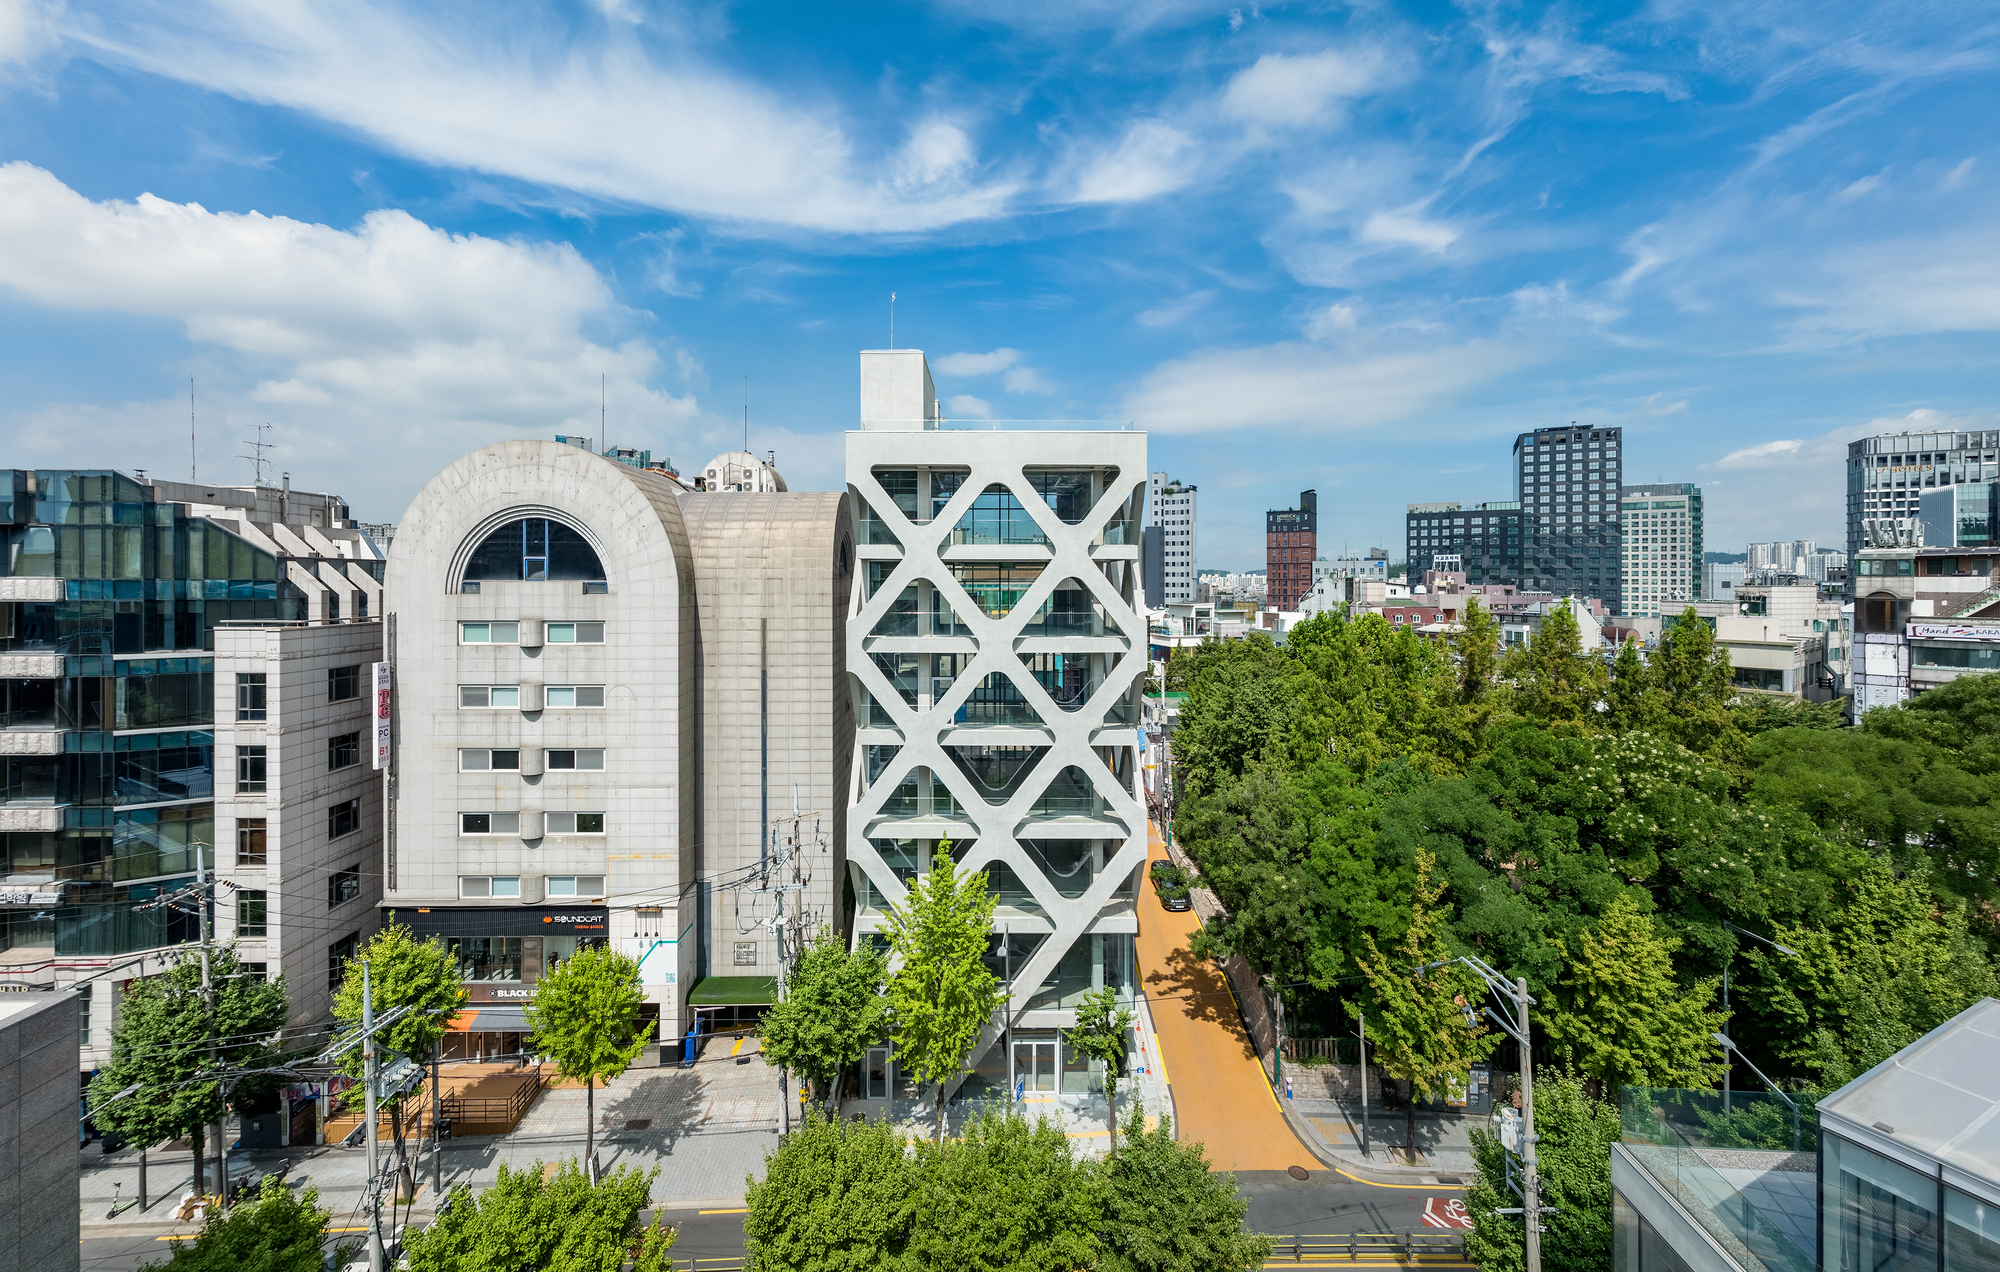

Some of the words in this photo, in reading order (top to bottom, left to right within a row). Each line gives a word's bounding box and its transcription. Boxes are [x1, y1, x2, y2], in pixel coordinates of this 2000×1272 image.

[1890, 464, 1933, 473] HOTELS
[379, 728, 389, 738] PC
[380, 745, 389, 755] B1
[554, 915, 603, 923] SOUNDCAT
[497, 989, 528, 998] BLACK
